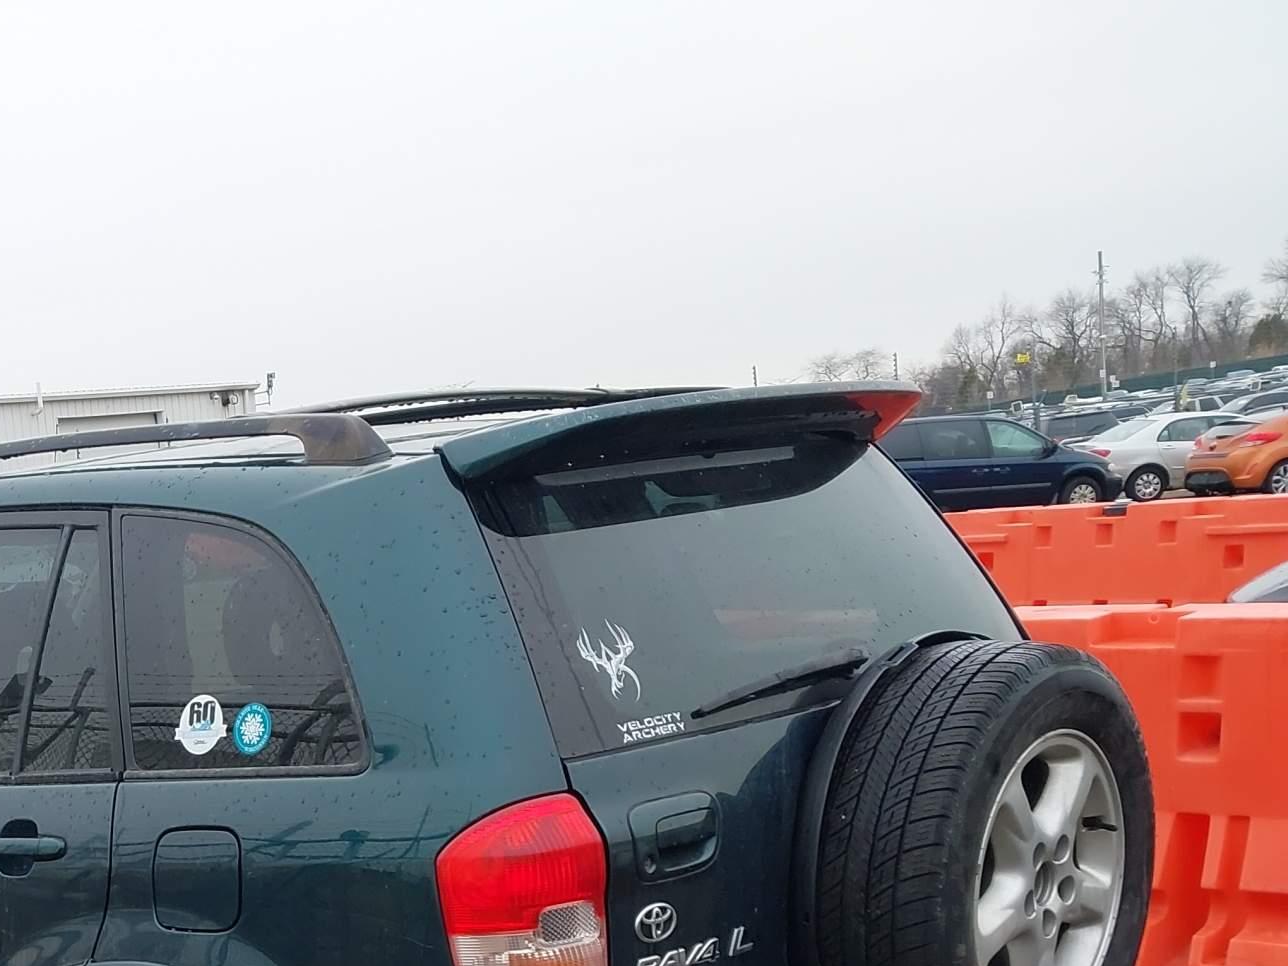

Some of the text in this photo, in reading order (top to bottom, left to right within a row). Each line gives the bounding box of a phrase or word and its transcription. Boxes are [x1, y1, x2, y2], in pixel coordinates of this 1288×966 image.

[189, 700, 216, 727] 60
[617, 712, 681, 732] VELOCITY
[623, 722, 685, 744] ARCHERY
